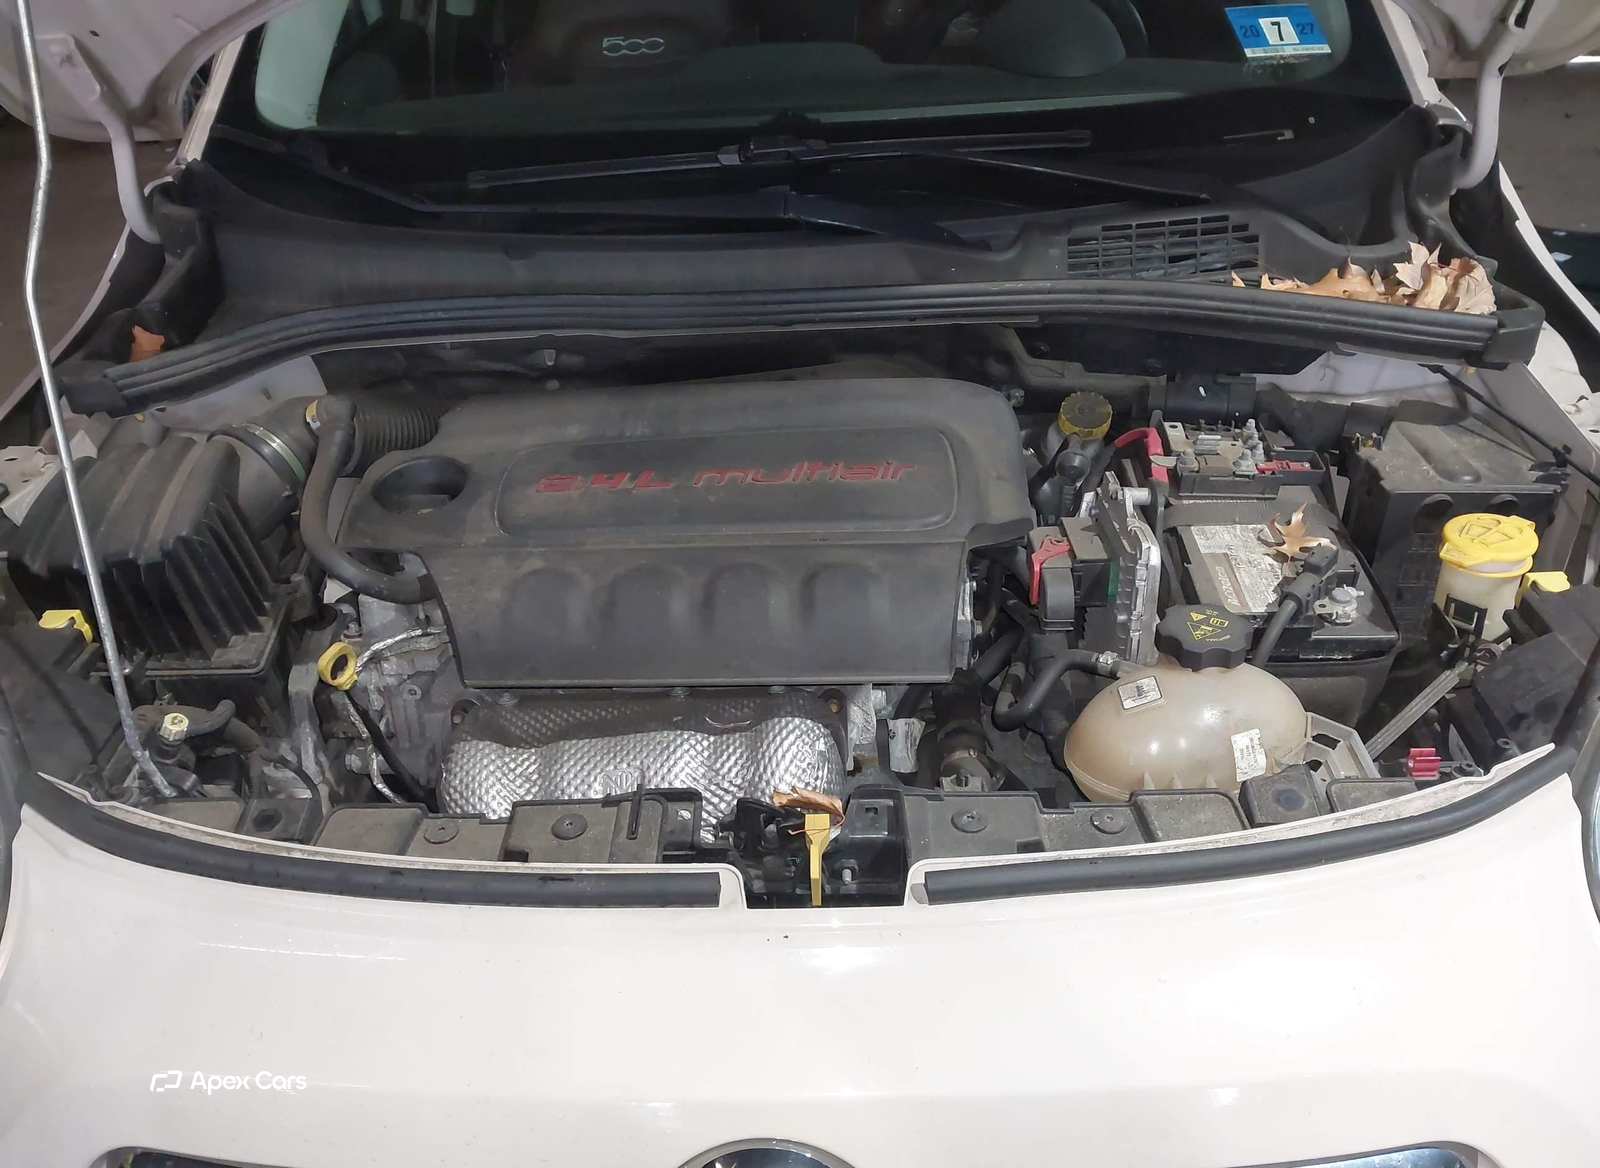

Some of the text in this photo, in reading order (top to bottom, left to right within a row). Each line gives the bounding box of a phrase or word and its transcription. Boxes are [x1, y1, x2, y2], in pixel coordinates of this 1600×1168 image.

[1240, 21, 1314, 41] 20 7 27
[602, 36, 665, 56] 500
[693, 461, 917, 487] multiair
